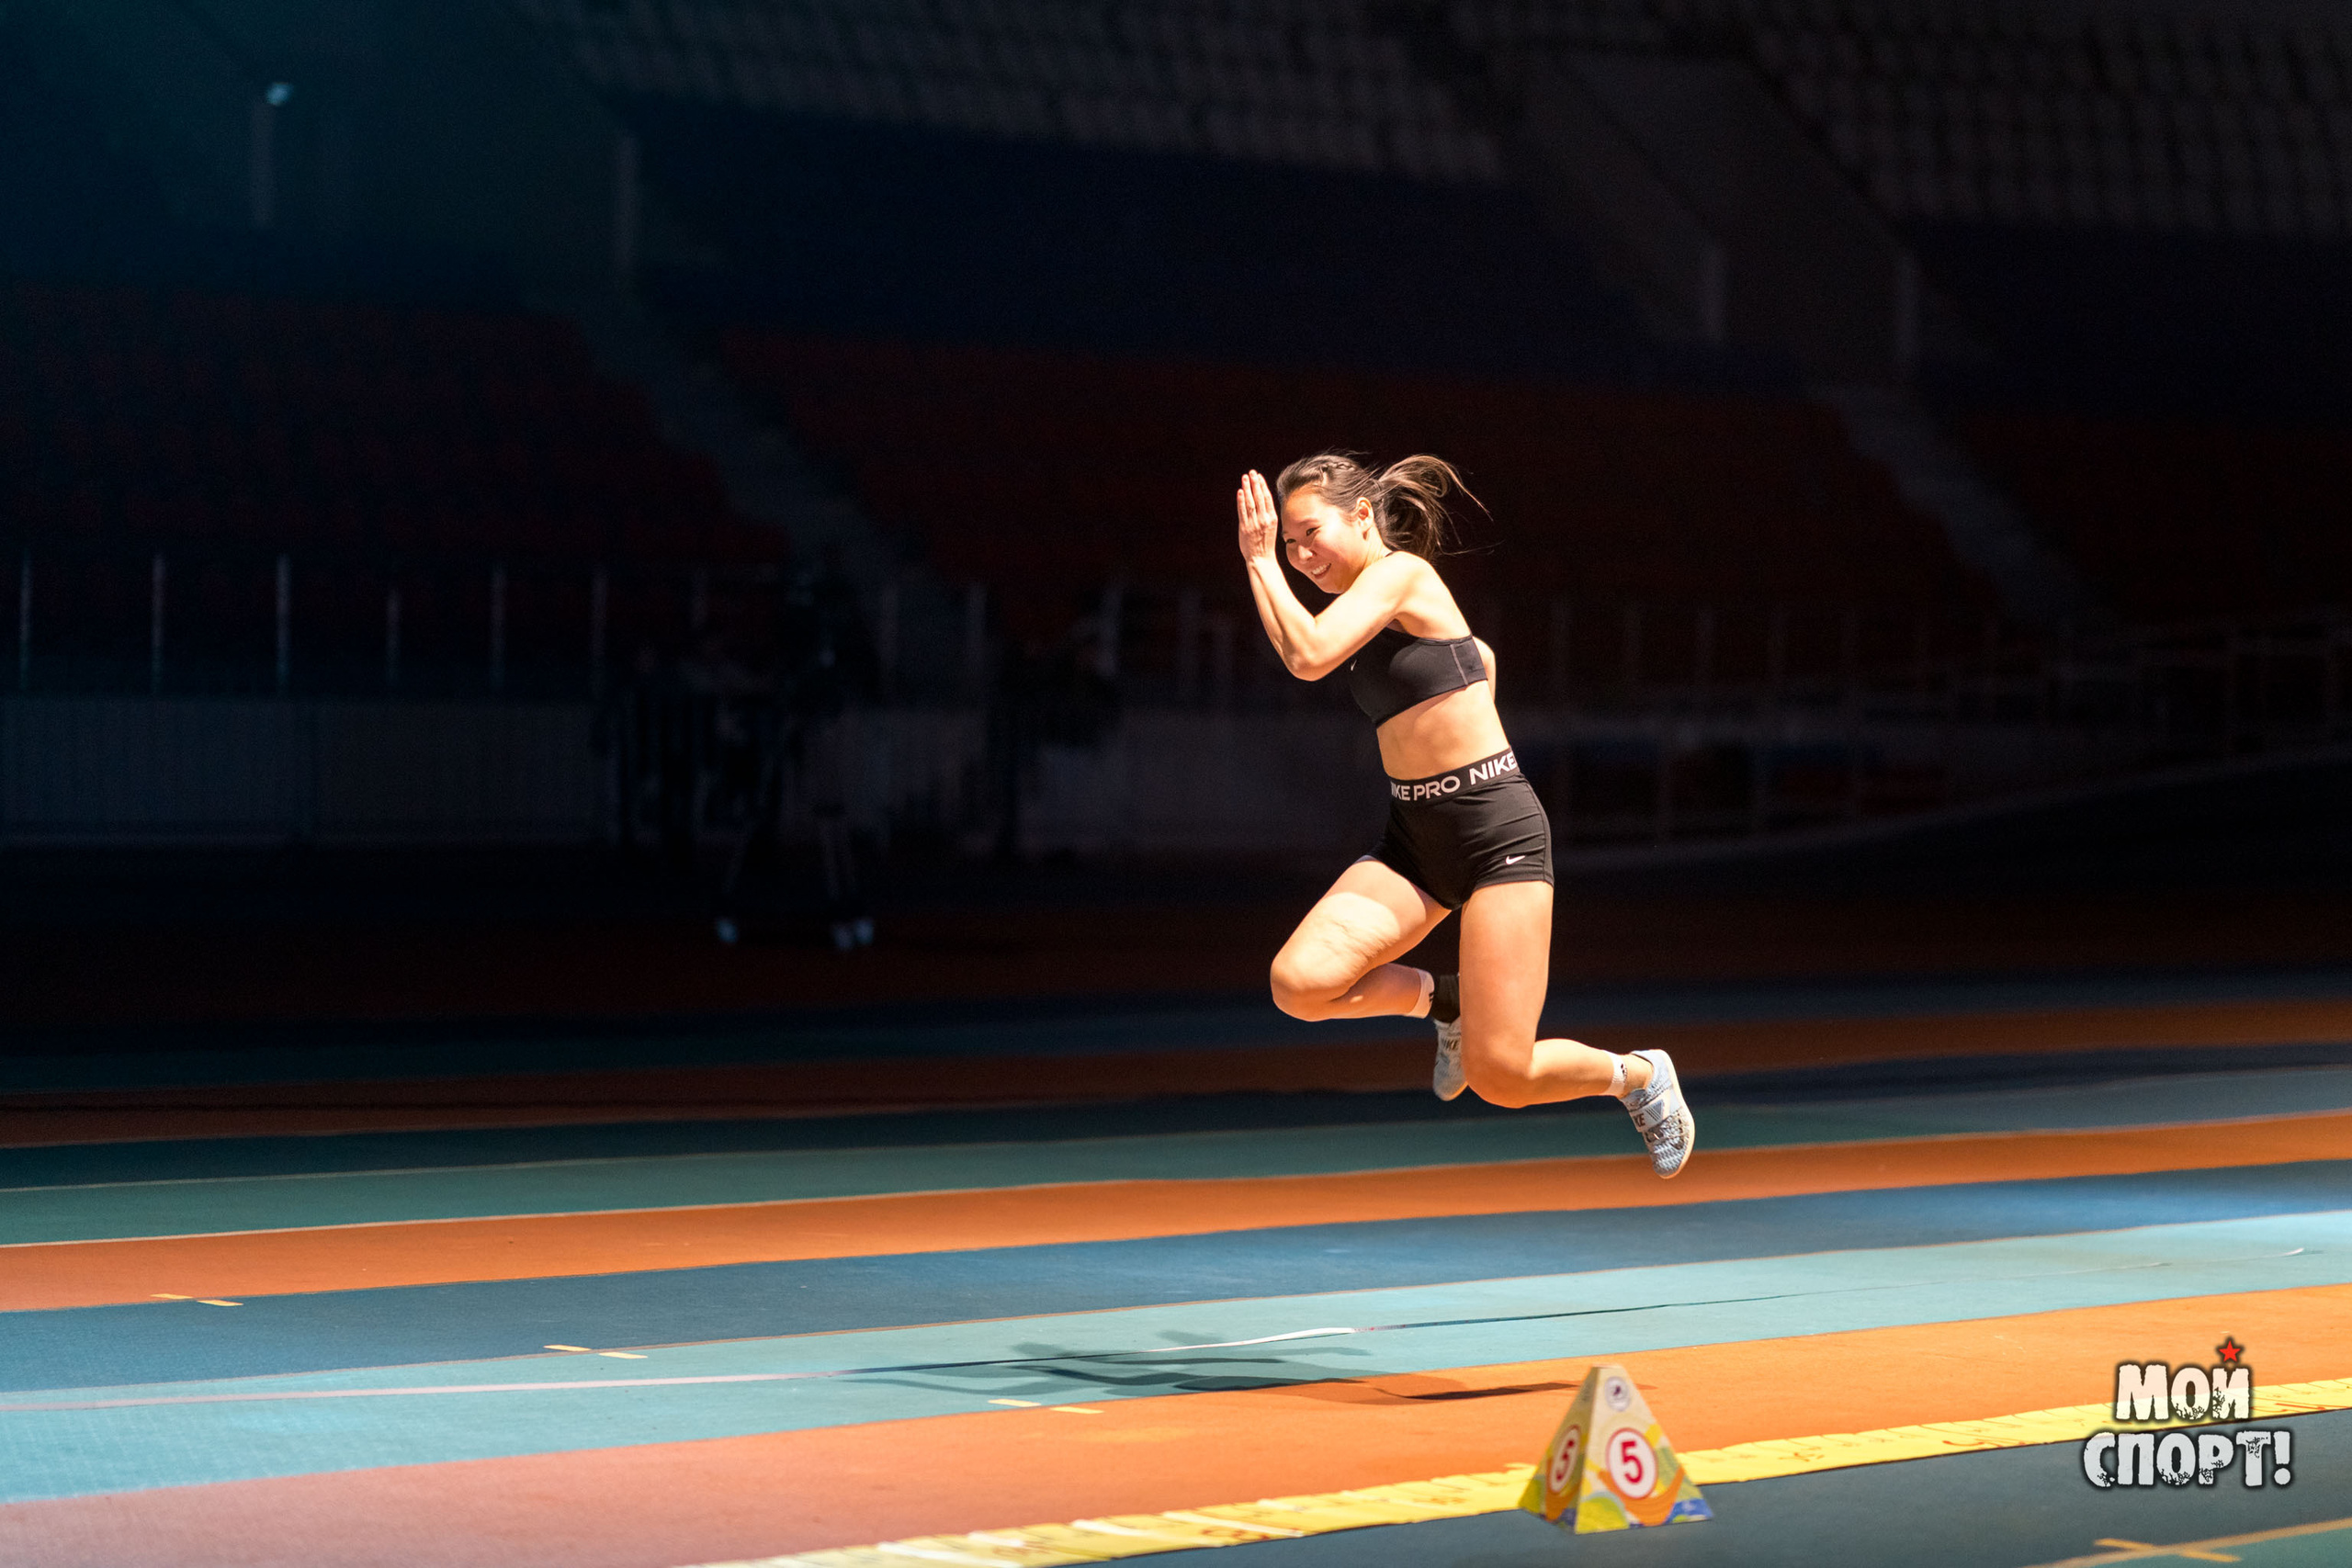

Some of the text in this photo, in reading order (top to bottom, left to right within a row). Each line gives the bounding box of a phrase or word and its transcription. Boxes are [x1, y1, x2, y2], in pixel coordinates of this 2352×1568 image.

[1413, 775, 1461, 801] PRO
[1469, 750, 1517, 785] NIKE
[1556, 1438, 1576, 1482] 5
[1620, 1440, 1644, 1483] 5
